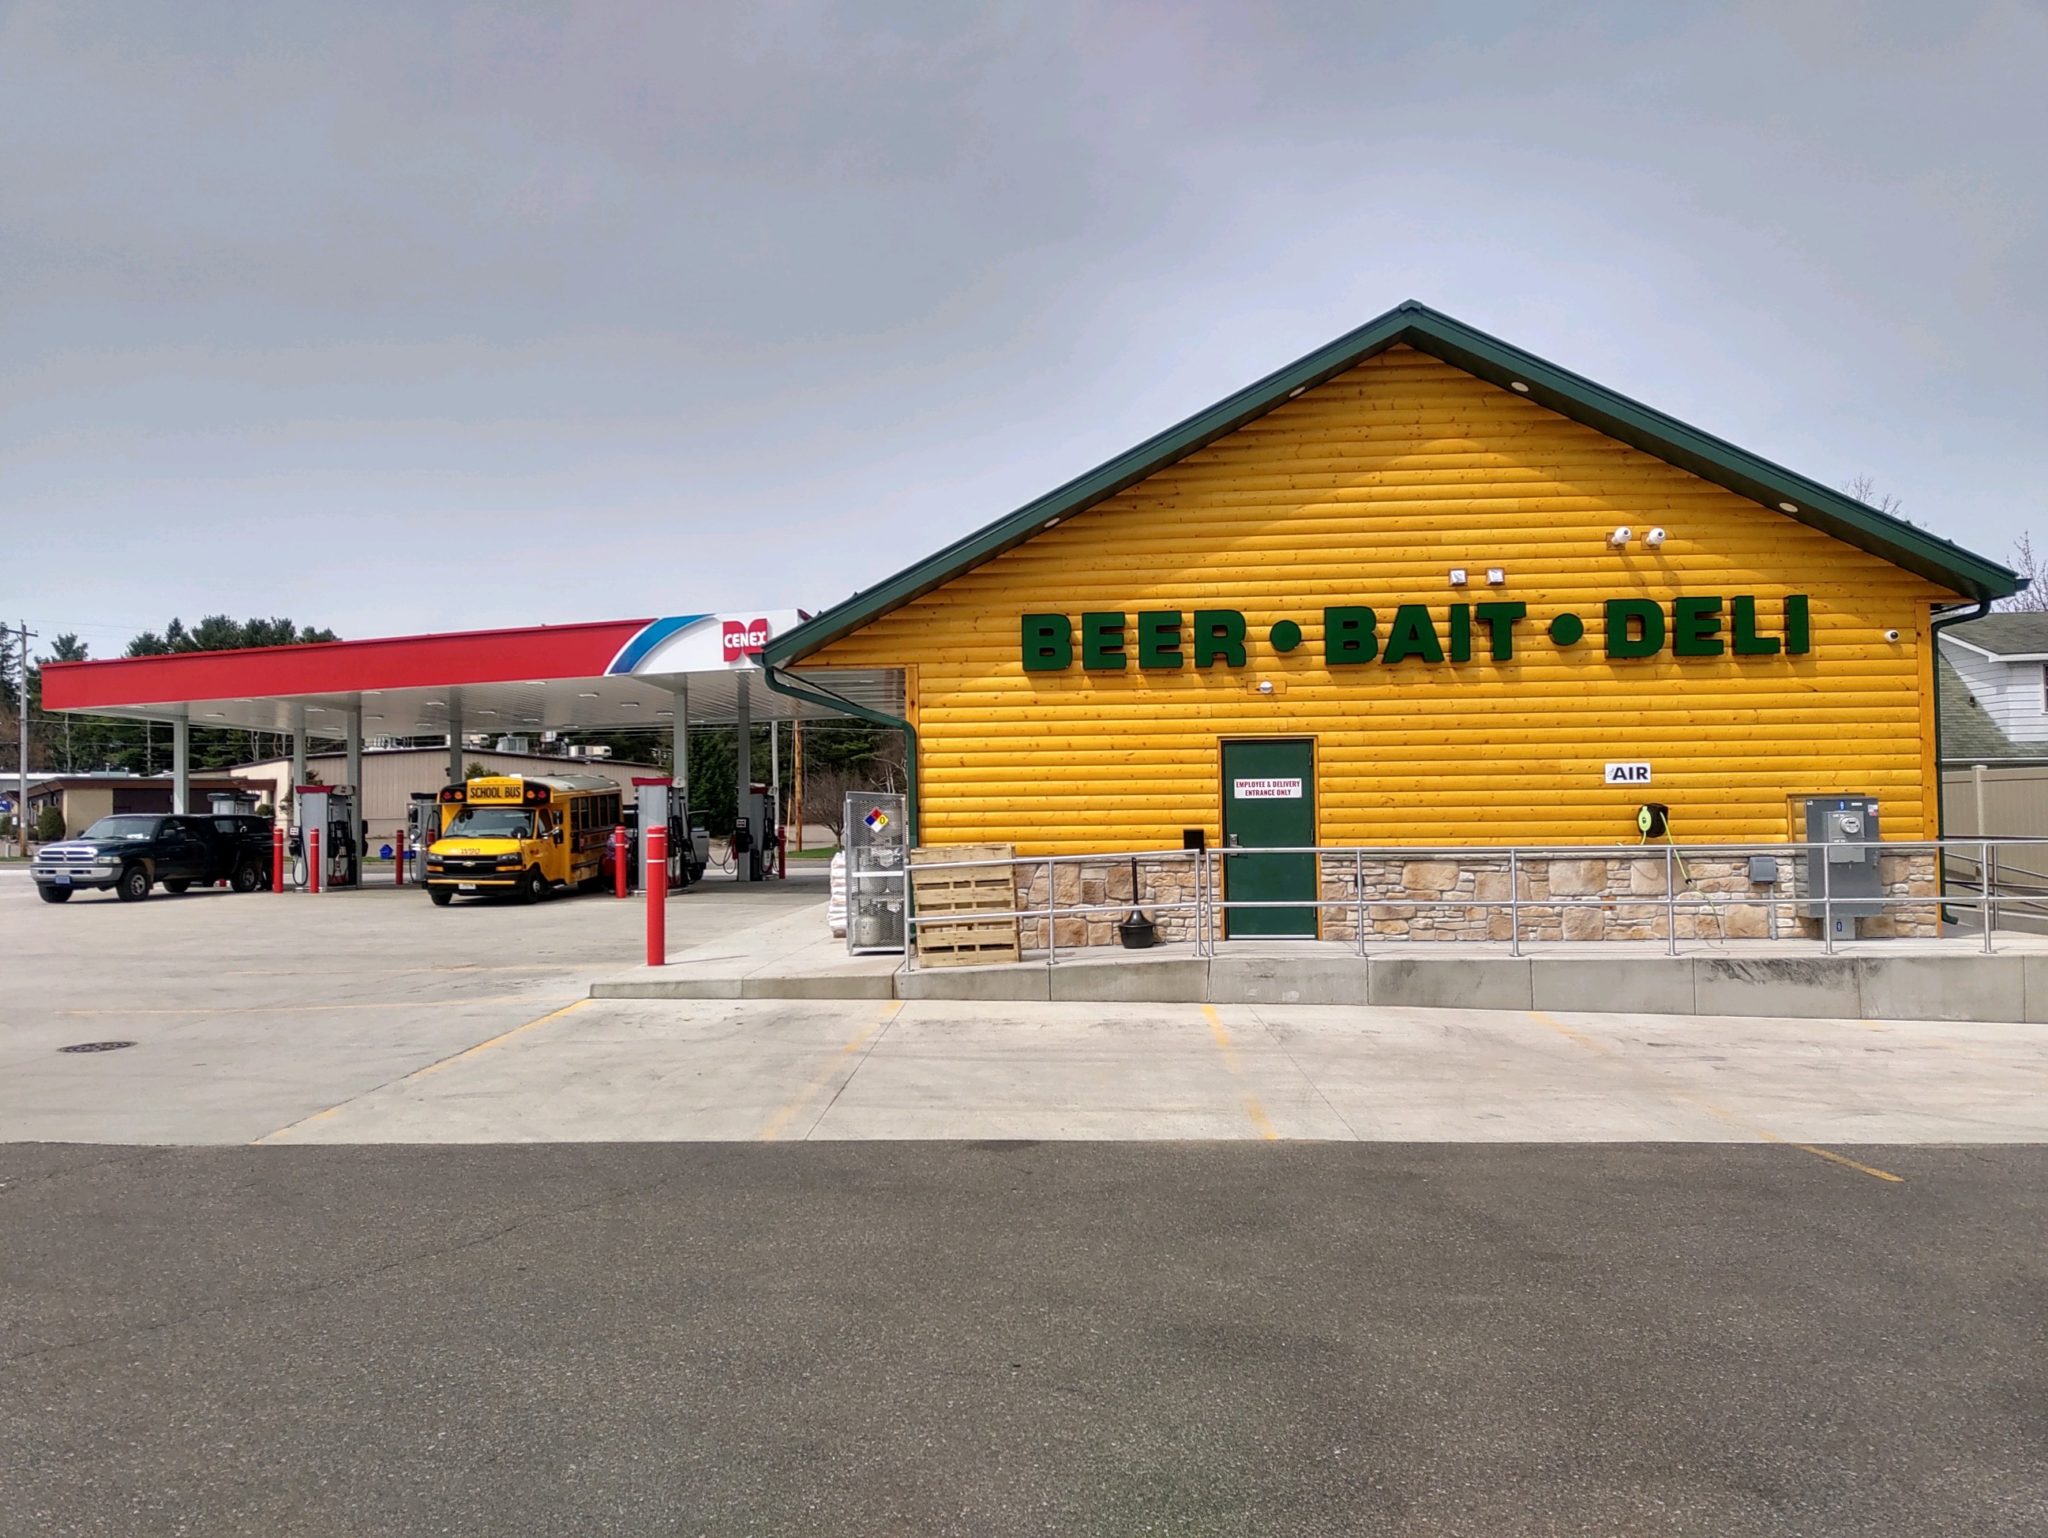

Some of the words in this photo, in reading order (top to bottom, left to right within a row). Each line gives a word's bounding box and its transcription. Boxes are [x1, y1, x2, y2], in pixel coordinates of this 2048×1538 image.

[724, 631, 767, 648] CENEX
[1021, 609, 1247, 672] BEER
[1324, 601, 1527, 665] BAIT
[1604, 594, 1810, 659] DELI
[1612, 766, 1649, 780] AIR
[1272, 780, 1300, 788] DELIVERY
[470, 786, 501, 798] SCHOOL
[504, 786, 521, 798] BUS
